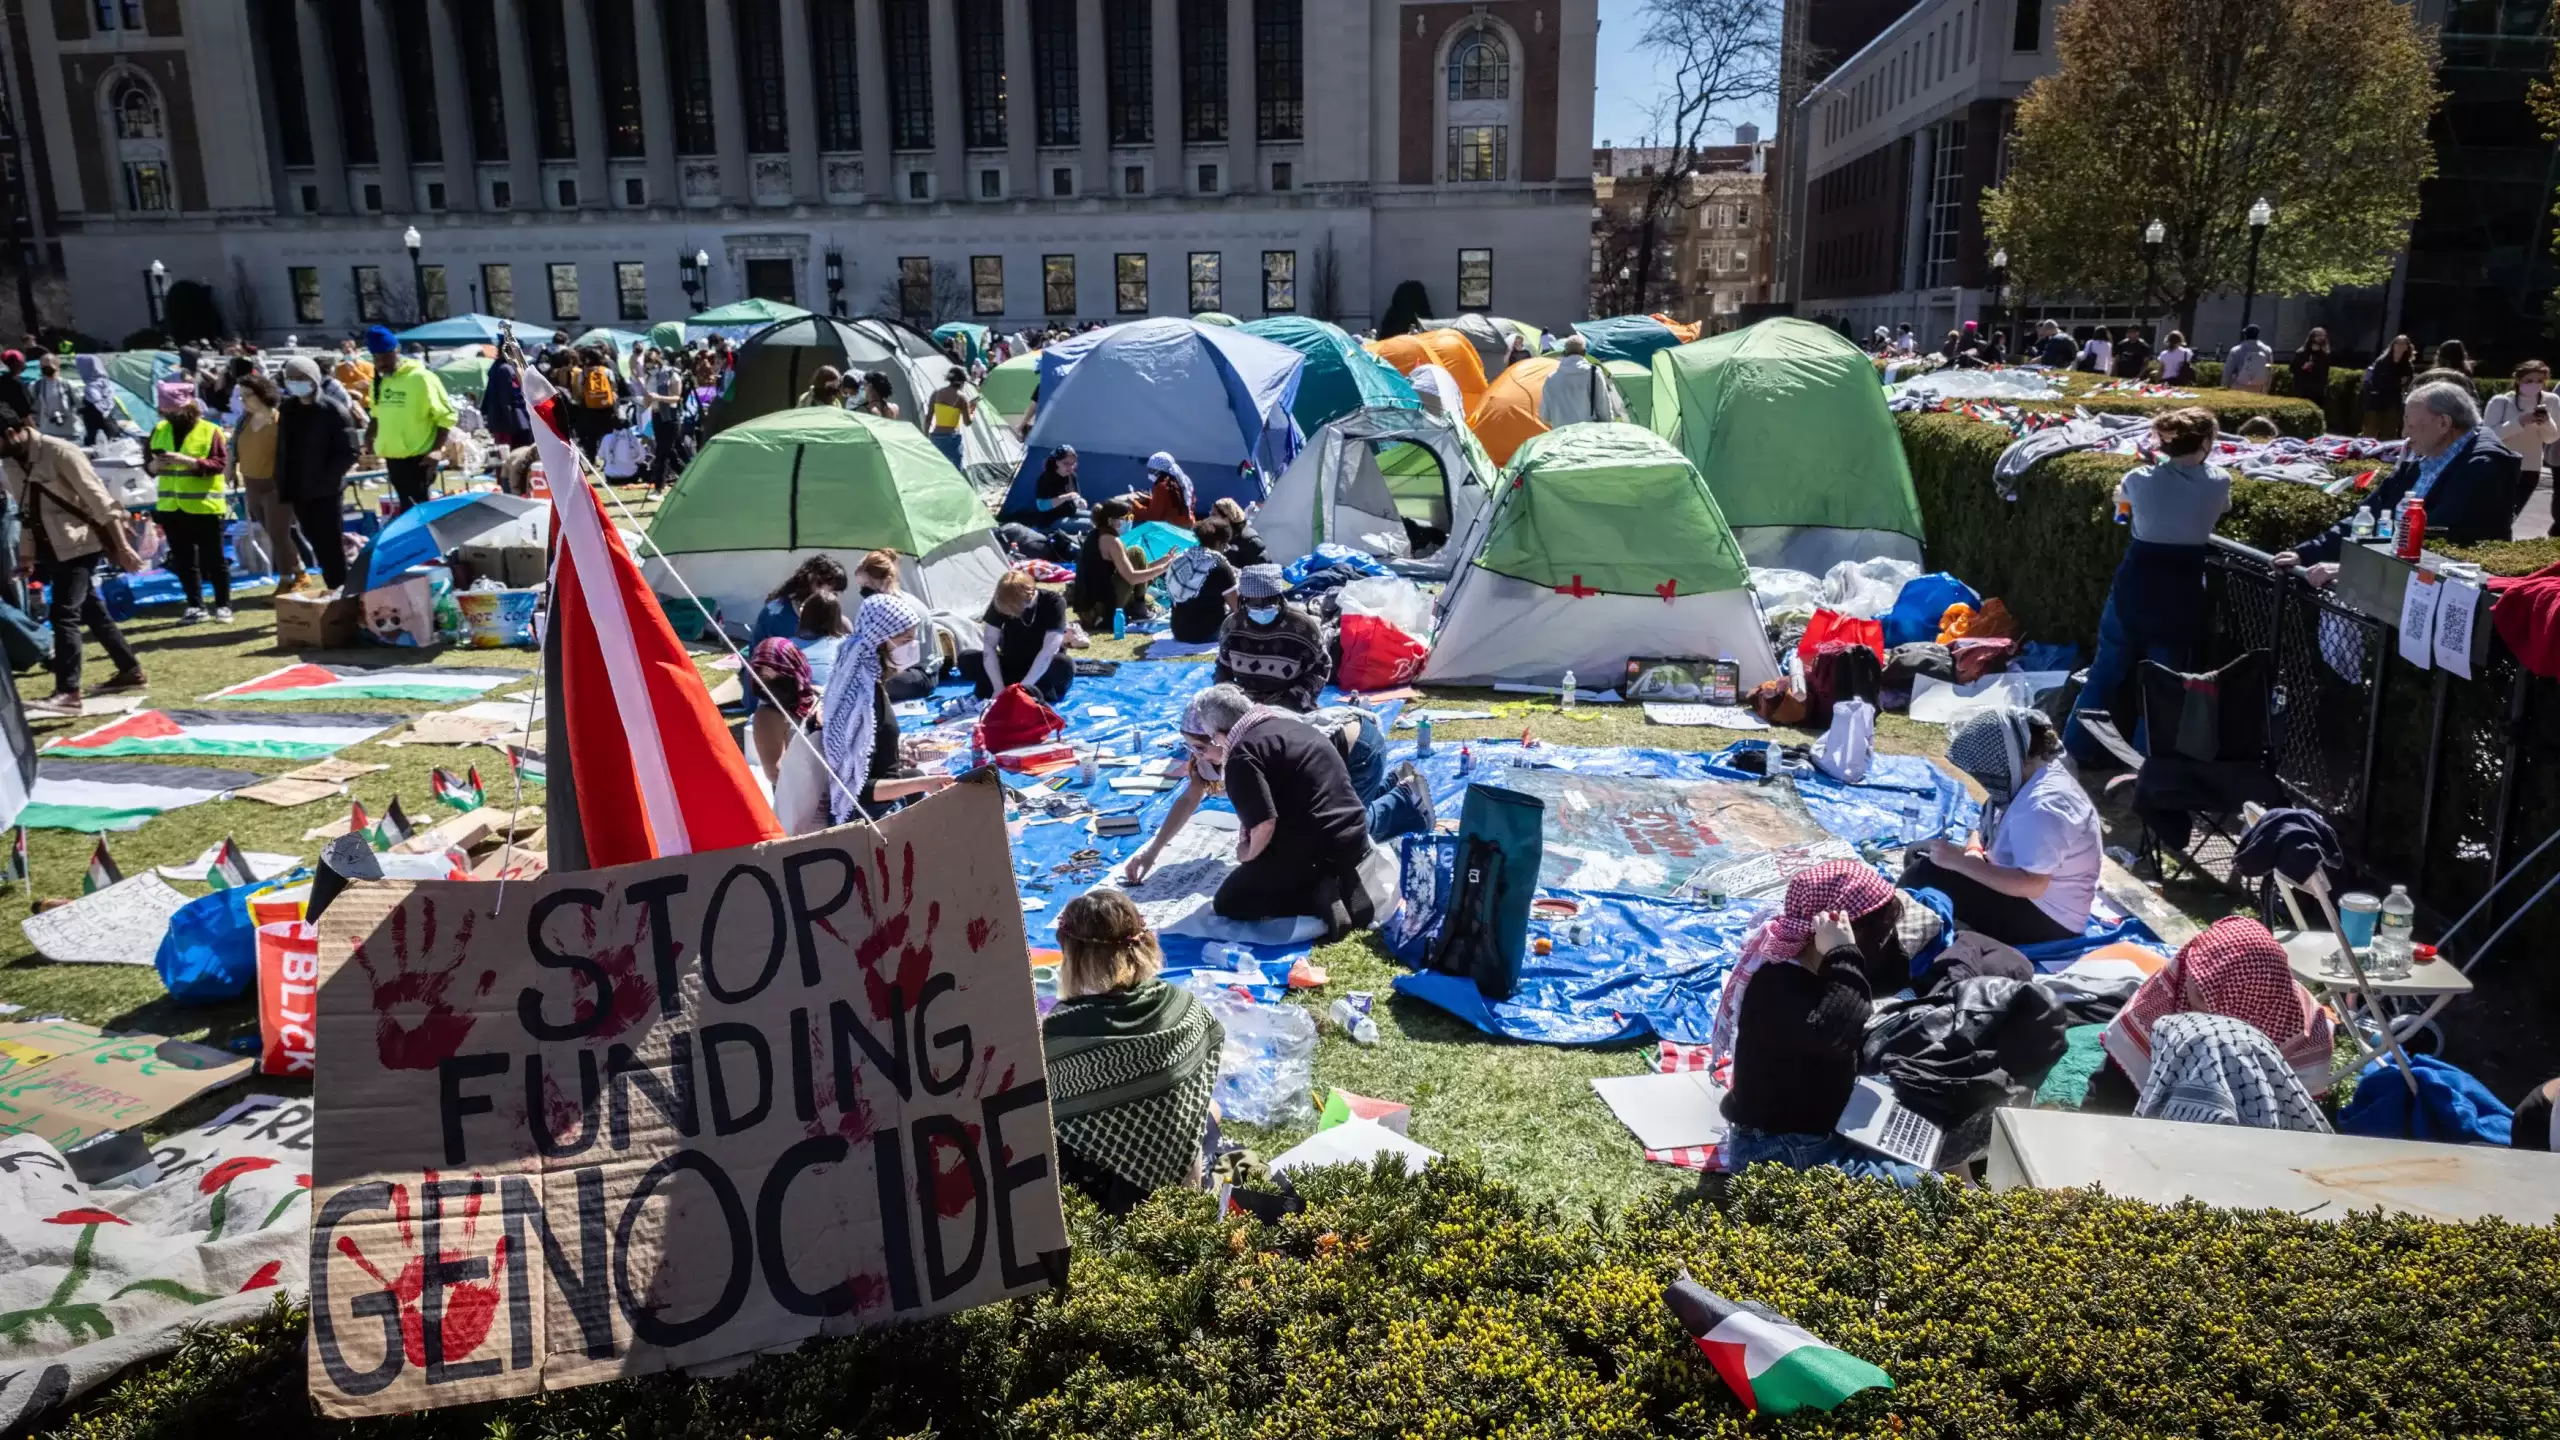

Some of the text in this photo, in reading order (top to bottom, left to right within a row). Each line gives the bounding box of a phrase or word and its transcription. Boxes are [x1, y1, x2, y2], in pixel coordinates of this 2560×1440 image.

[279, 951, 319, 1074] BLICK
[516, 847, 858, 1042] STOP
[437, 972, 975, 1166] FUNDING
[309, 1078, 1051, 1397] GENOCIDE
